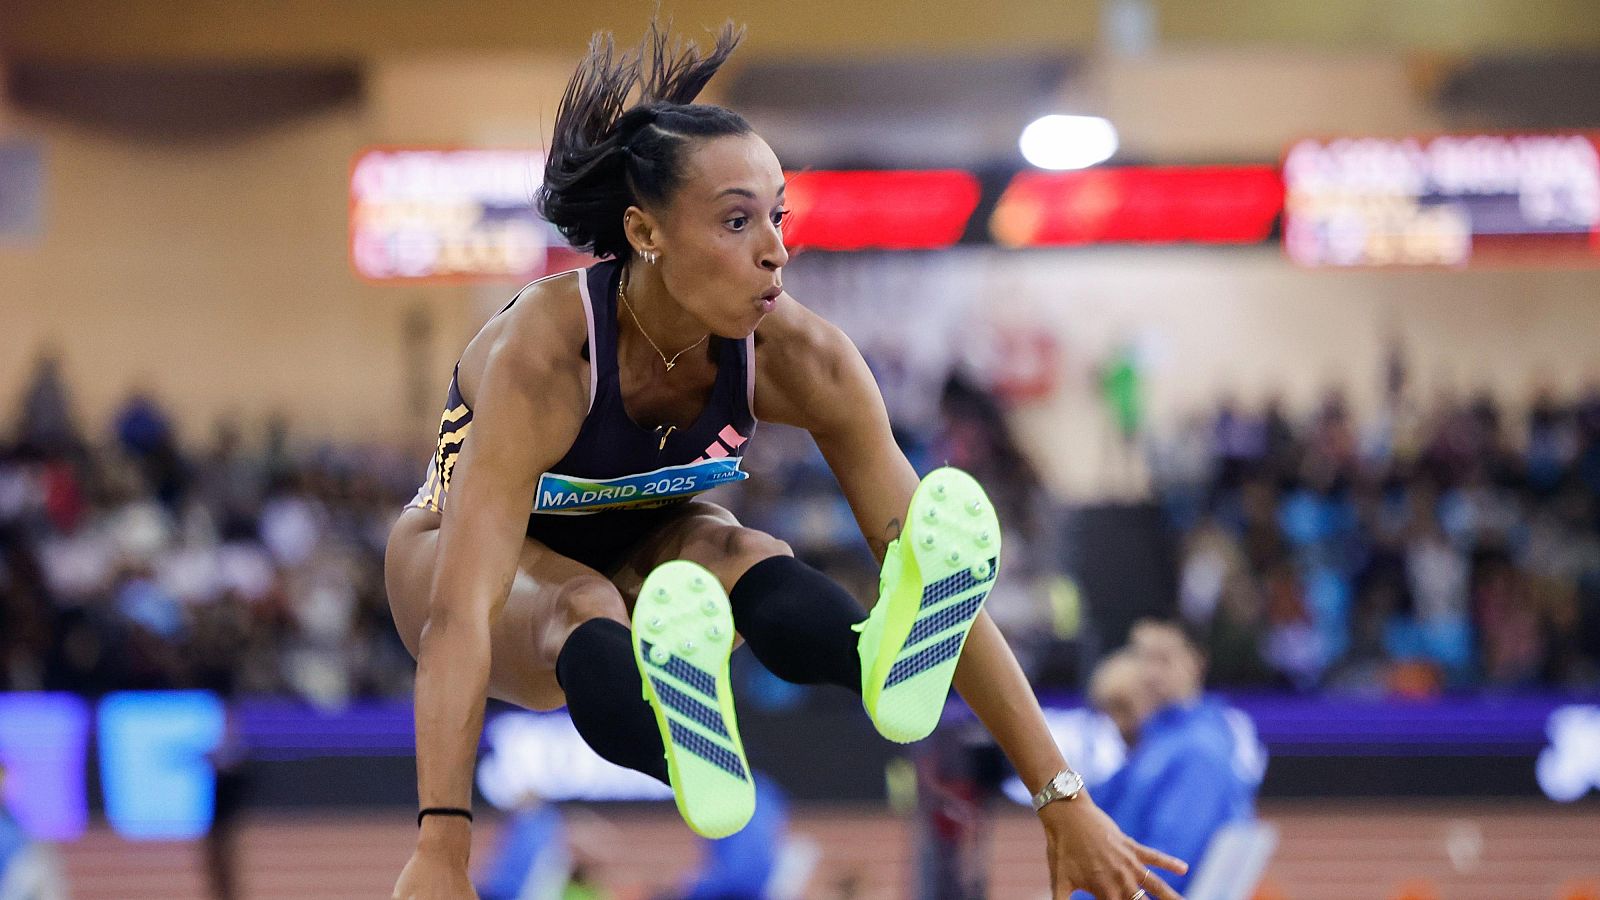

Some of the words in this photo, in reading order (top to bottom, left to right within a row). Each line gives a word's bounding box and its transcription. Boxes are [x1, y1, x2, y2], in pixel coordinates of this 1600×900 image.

[712, 471, 735, 480] TEAM
[542, 485, 637, 507] MADRID
[642, 476, 697, 496] 2025
